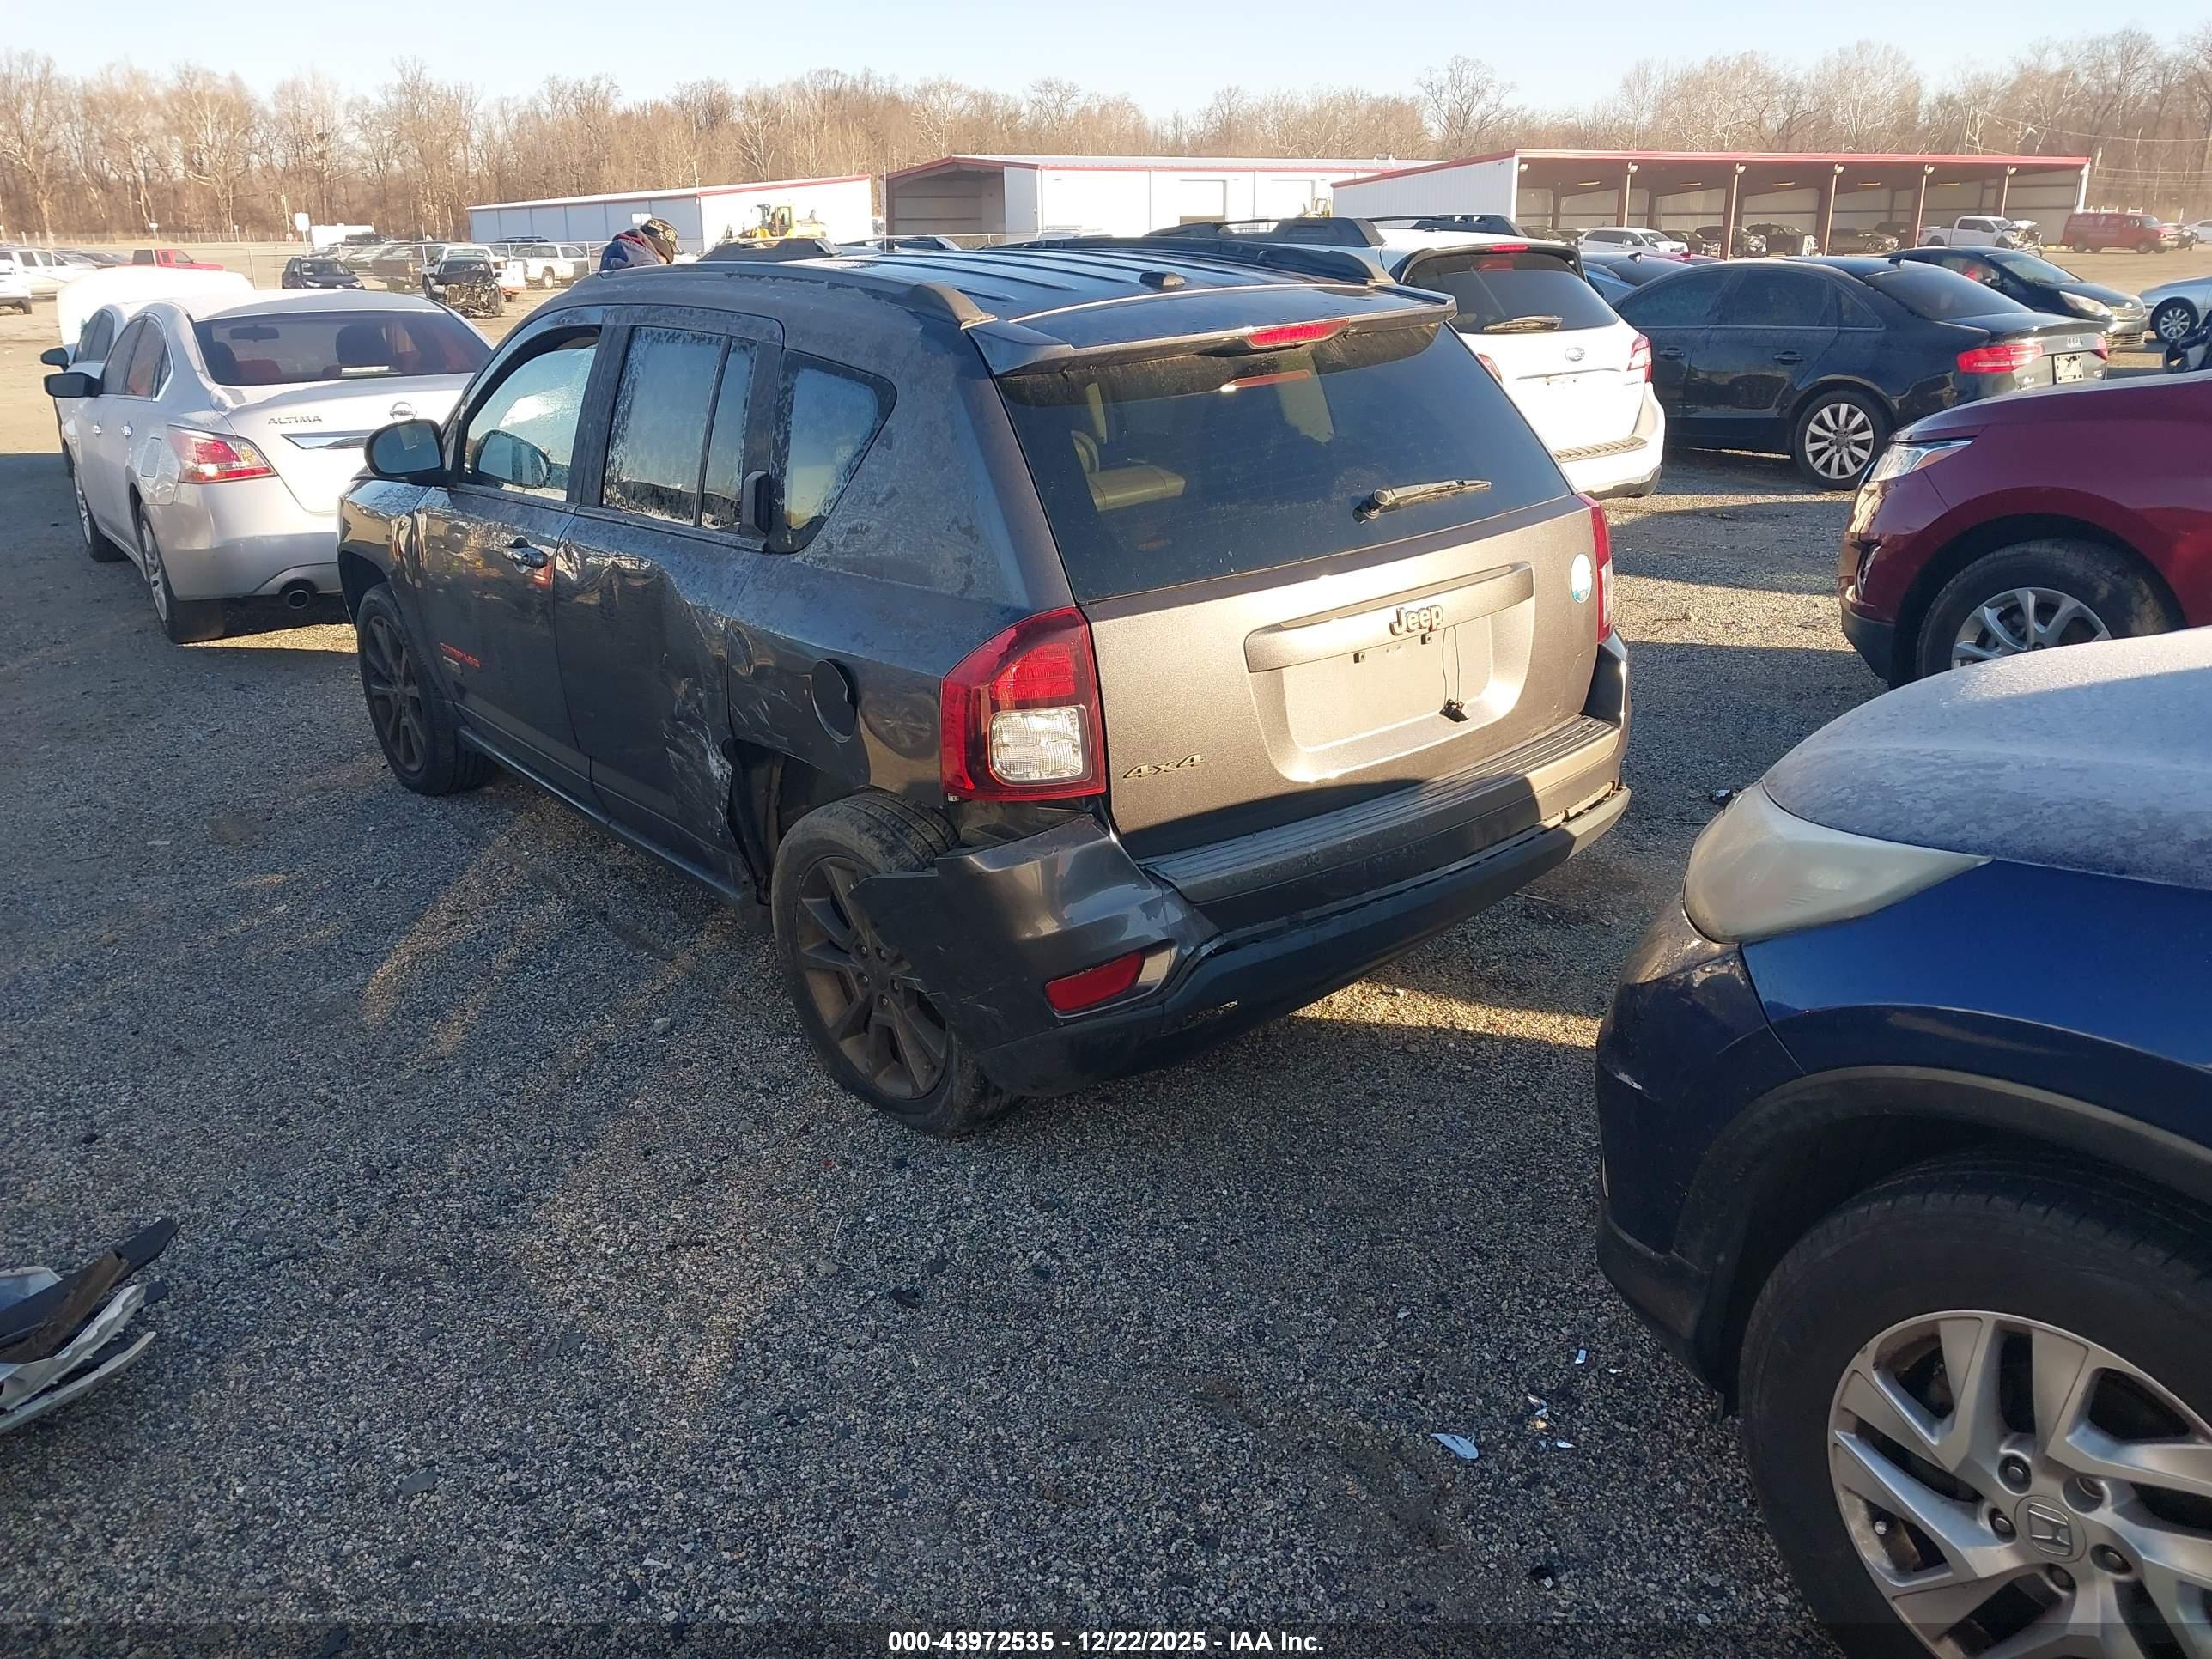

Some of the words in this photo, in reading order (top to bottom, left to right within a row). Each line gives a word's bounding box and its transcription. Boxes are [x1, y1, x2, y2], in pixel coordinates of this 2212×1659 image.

[268, 416, 323, 425] ALTIMA
[1389, 604, 1443, 636] Jeep
[1122, 753, 1204, 779] 4x4
